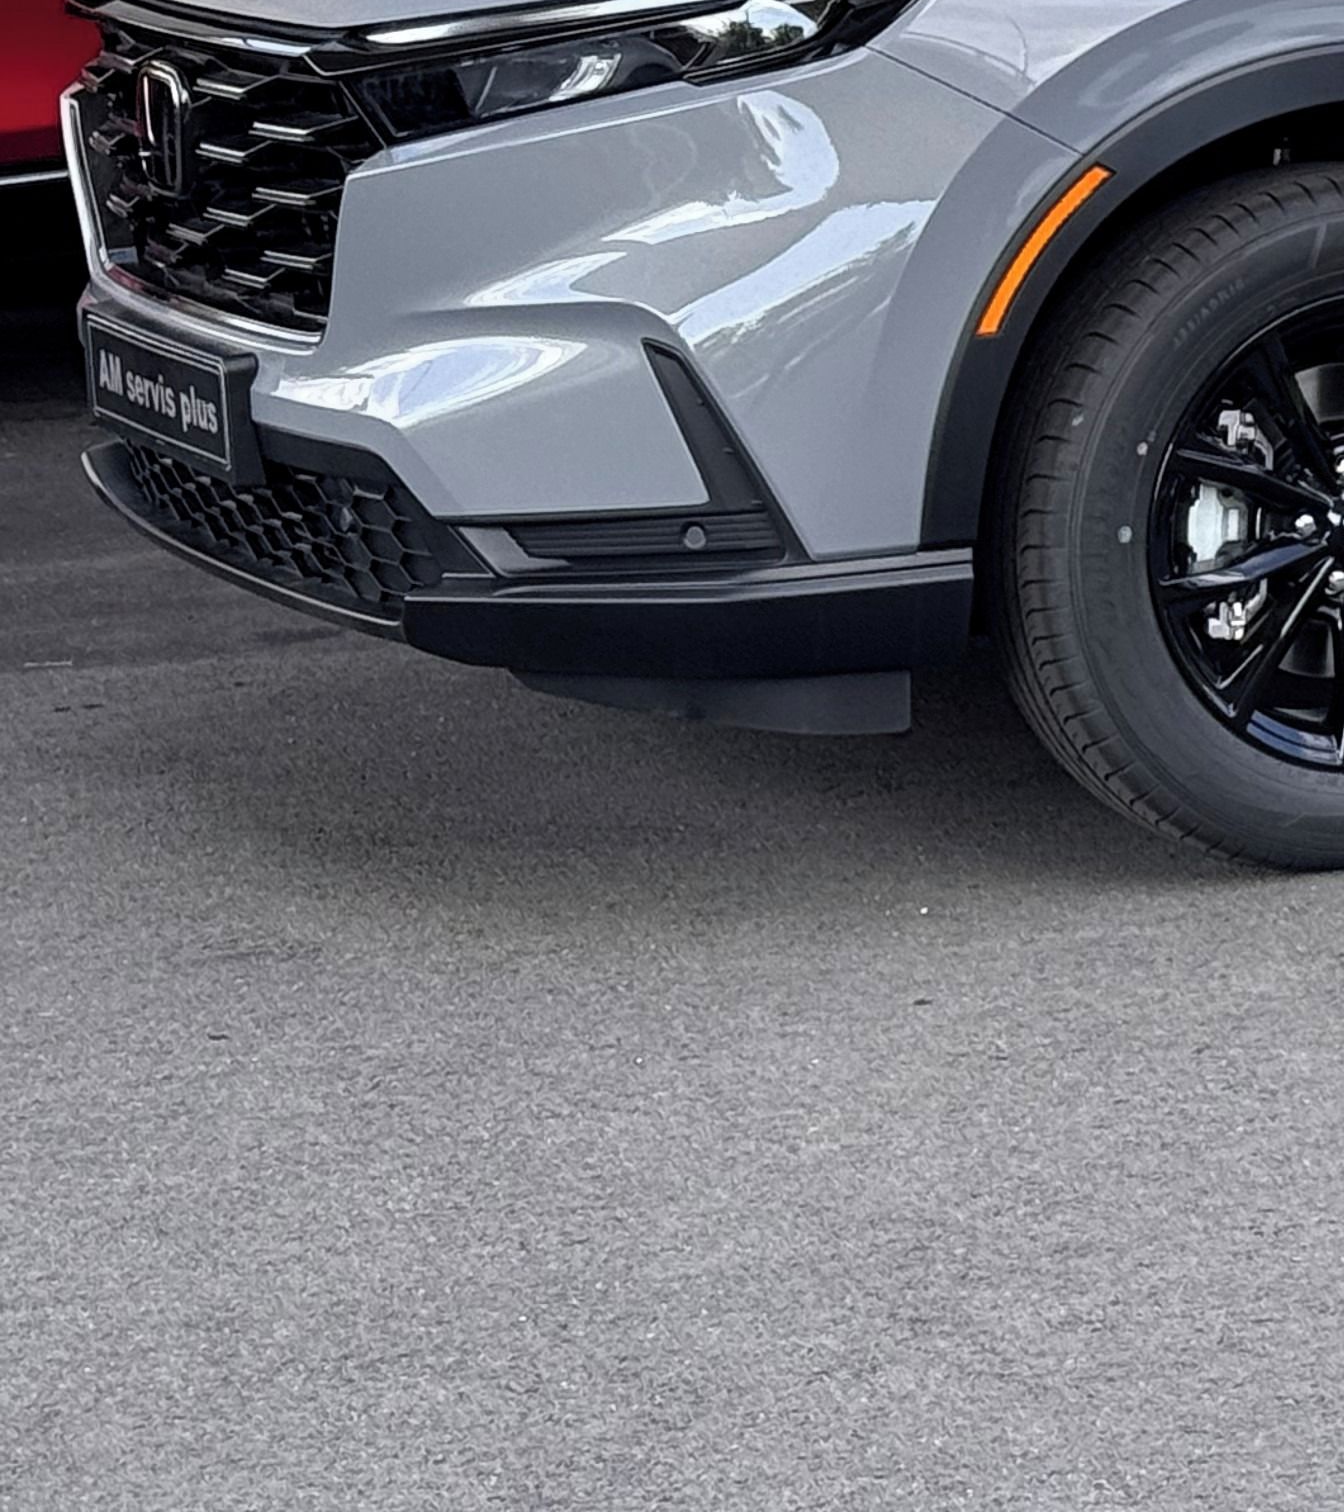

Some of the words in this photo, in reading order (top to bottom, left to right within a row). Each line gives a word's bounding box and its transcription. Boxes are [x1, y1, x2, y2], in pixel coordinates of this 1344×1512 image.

[99, 348, 124, 397] AM
[126, 371, 177, 418] servis
[179, 384, 219, 434] plus
